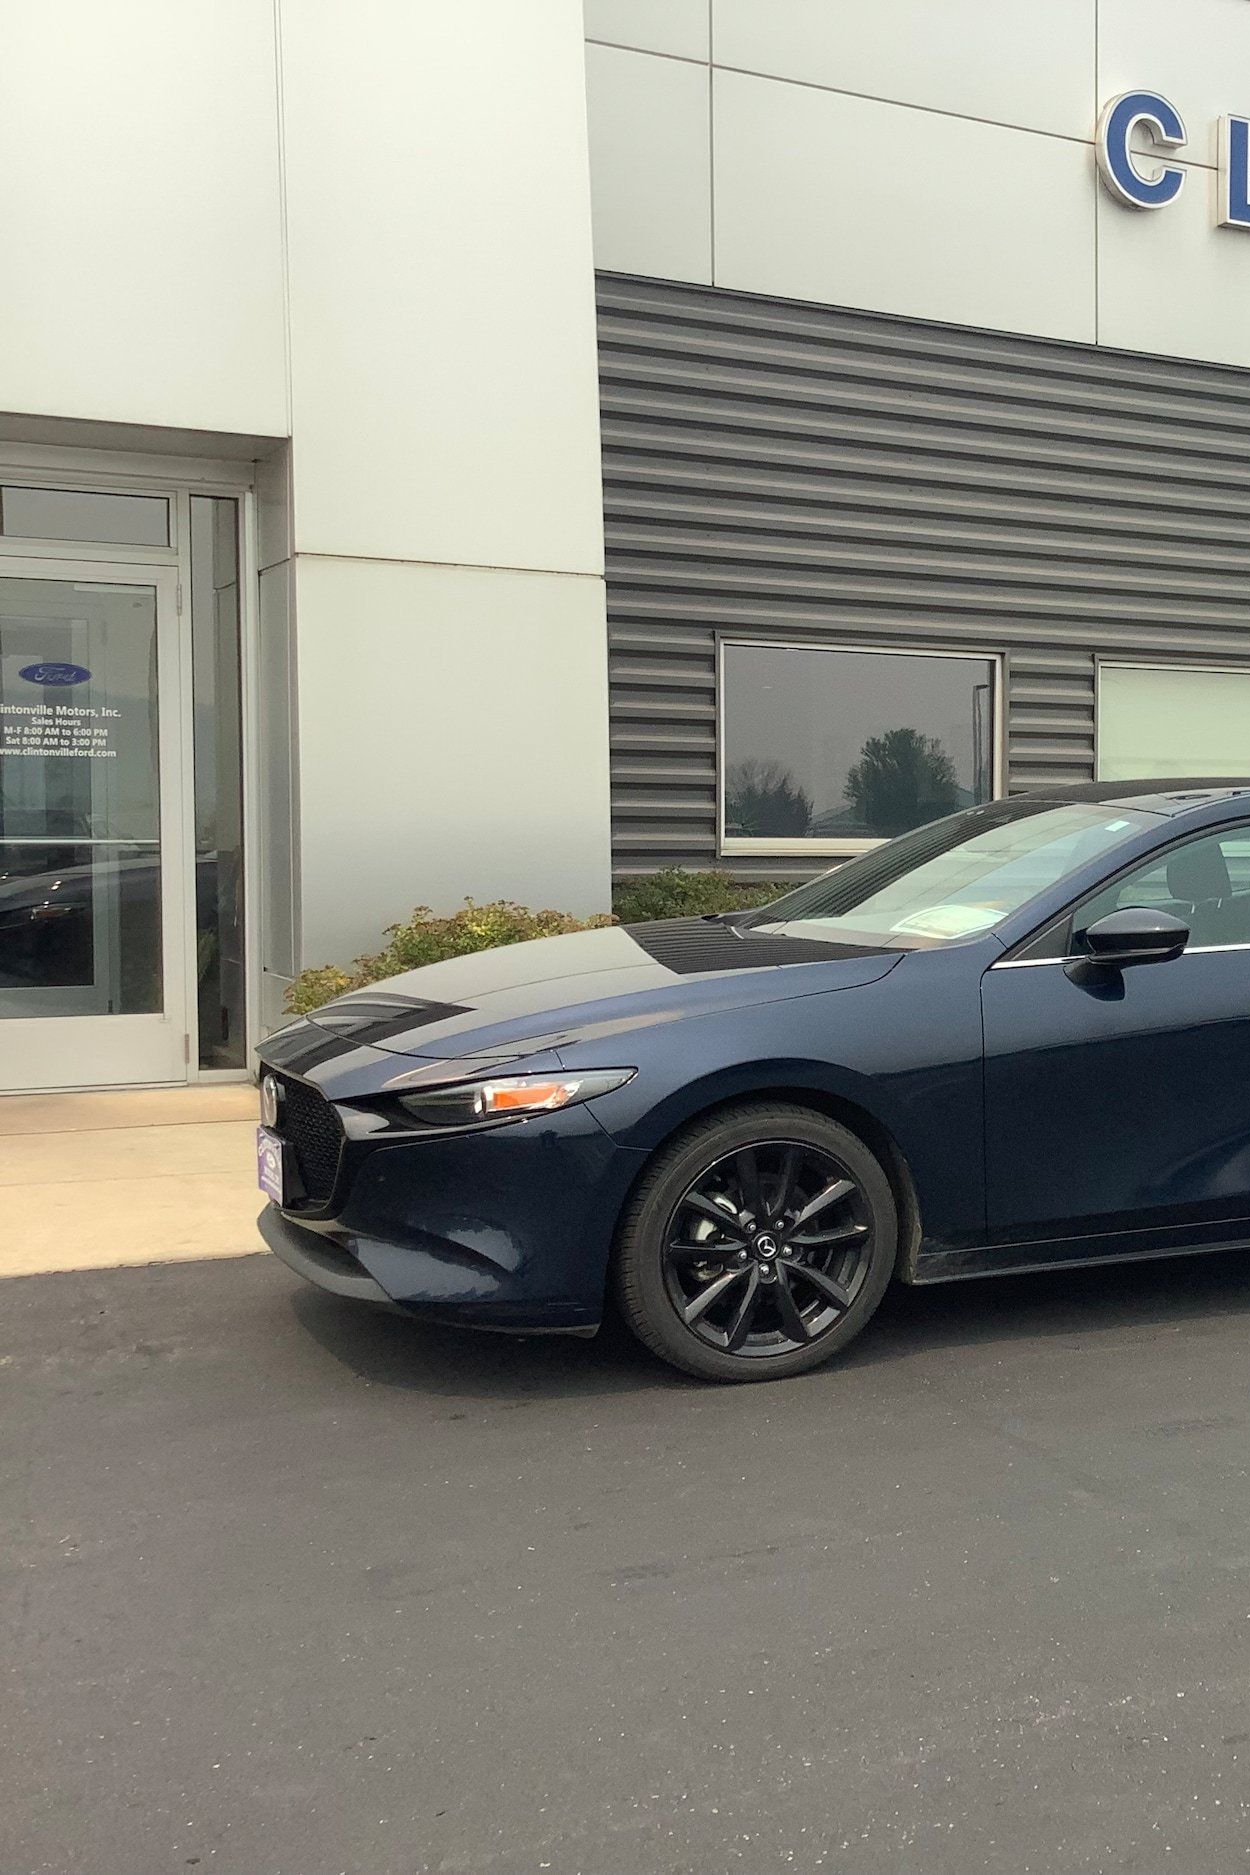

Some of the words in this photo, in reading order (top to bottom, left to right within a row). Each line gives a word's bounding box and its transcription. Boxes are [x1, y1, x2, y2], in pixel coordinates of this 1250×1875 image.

[34, 666, 77, 681] Ford
[0, 704, 53, 715] intonville
[56, 706, 99, 718] Motors,
[101, 707, 121, 717] Inc.
[31, 717, 53, 725] Sales
[55, 718, 81, 726] Hours
[4, 726, 22, 734] M-F
[24, 726, 43, 735] 8:00
[45, 727, 59, 735] AM
[62, 727, 71, 736] to
[73, 728, 92, 737] 6:00
[94, 729, 108, 737] PM
[6, 736, 21, 745] Sat
[22, 737, 41, 745] 8:00
[43, 737, 58, 746] AM
[60, 738, 70, 746] to
[72, 738, 91, 747] 3:00
[92, 739, 107, 747] PM
